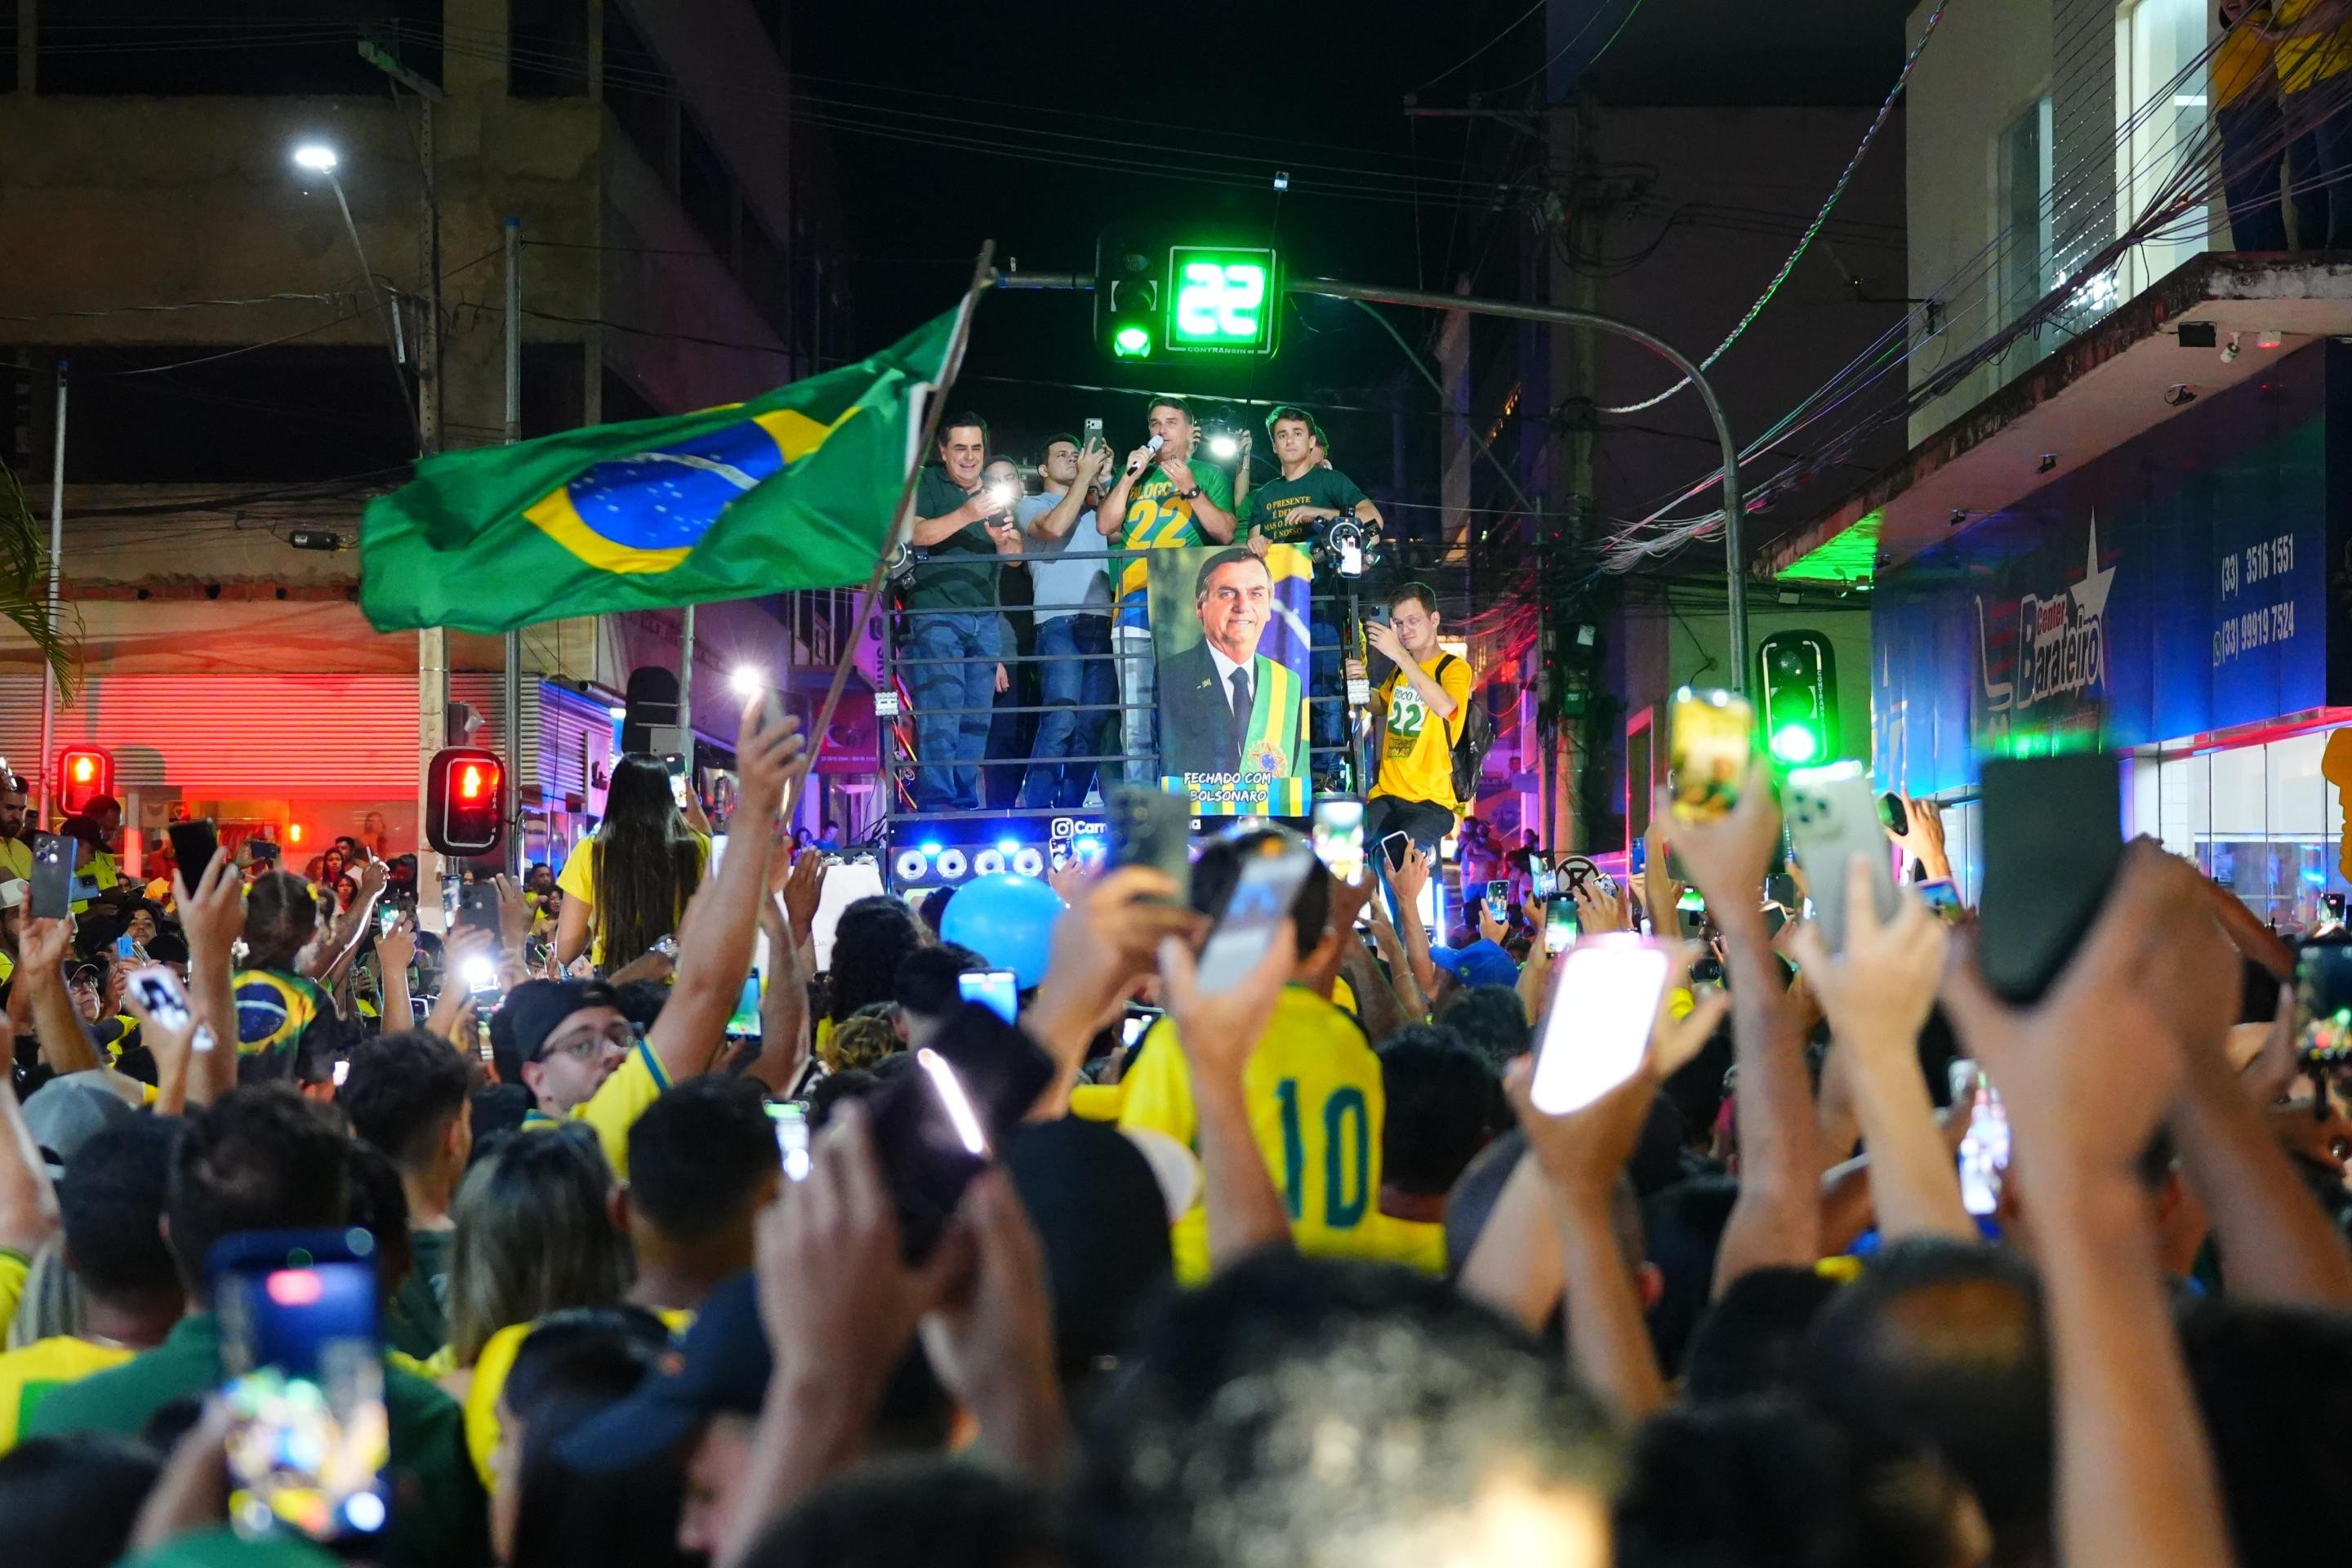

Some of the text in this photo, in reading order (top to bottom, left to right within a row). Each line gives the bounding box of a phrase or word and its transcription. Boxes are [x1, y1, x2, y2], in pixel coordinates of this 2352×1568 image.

[1178, 263, 1265, 336] 22
[1126, 497, 1192, 550] 22
[1267, 497, 1312, 510] O PRESENTE
[2221, 532, 2293, 601] (33) 3516 1551
[2038, 600, 2066, 635] Center
[2221, 600, 2295, 665] (33) 99919 7524
[2017, 595, 2100, 709] Barateiro
[1388, 701, 1422, 738] 22
[1184, 773, 1272, 786] FECHADO COM
[1190, 791, 1267, 802] BOLSONARO
[1276, 1078, 1370, 1228] 10
